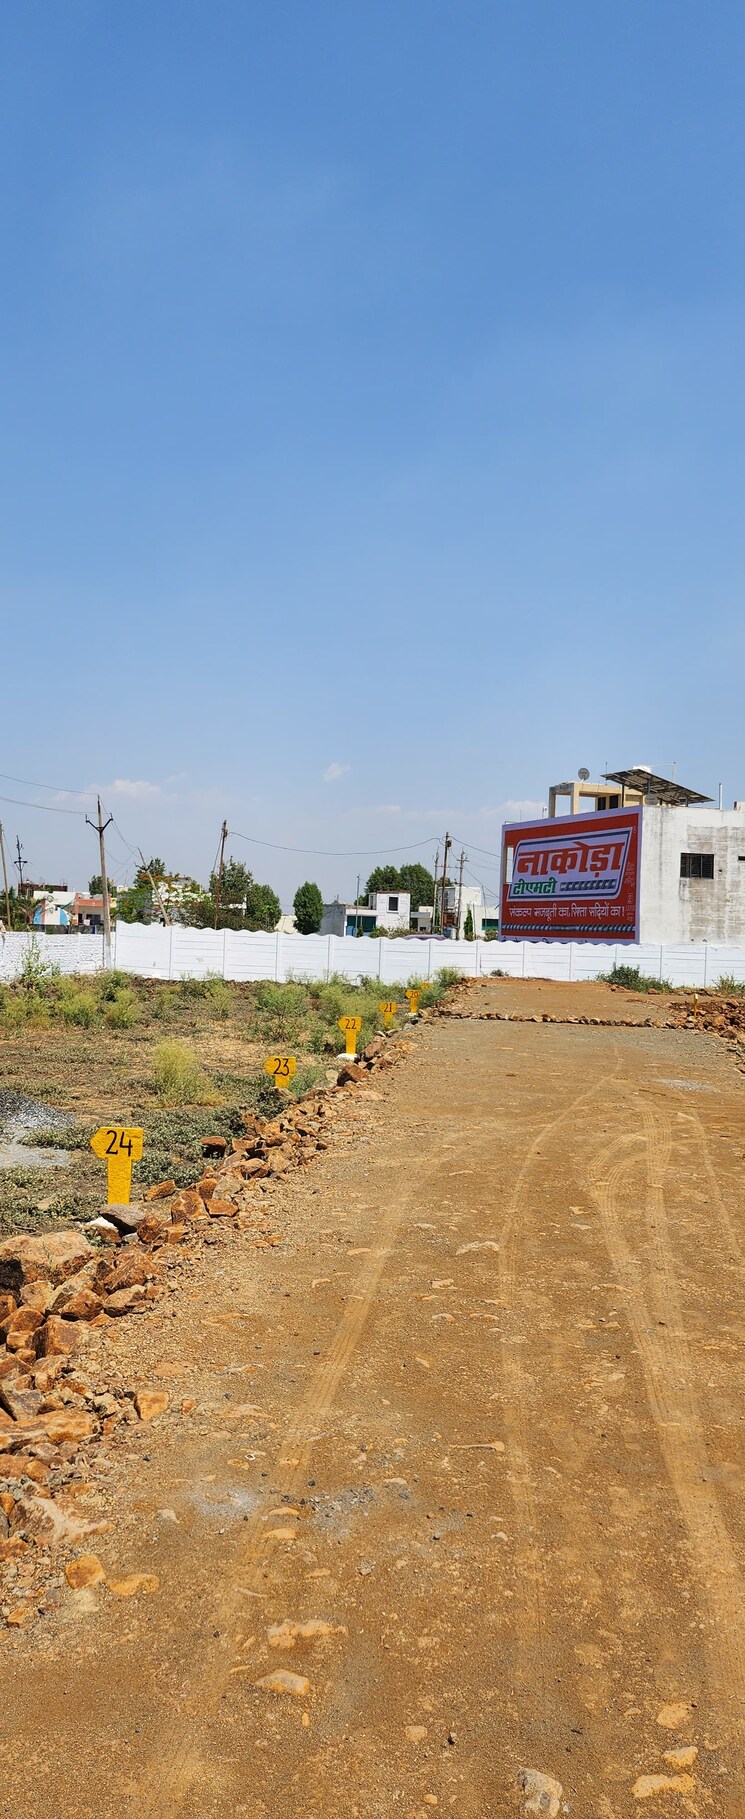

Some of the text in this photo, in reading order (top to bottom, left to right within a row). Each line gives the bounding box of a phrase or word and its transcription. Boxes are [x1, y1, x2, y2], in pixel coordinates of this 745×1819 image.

[517, 841, 625, 877] नाकोड़ा
[513, 877, 557, 895] टीएमटी
[410, 990, 418, 998] 20
[384, 1003, 392, 1012] 21
[345, 1019, 357, 1029] 22
[274, 1058, 290, 1076] 23
[105, 1130, 133, 1157] 24
